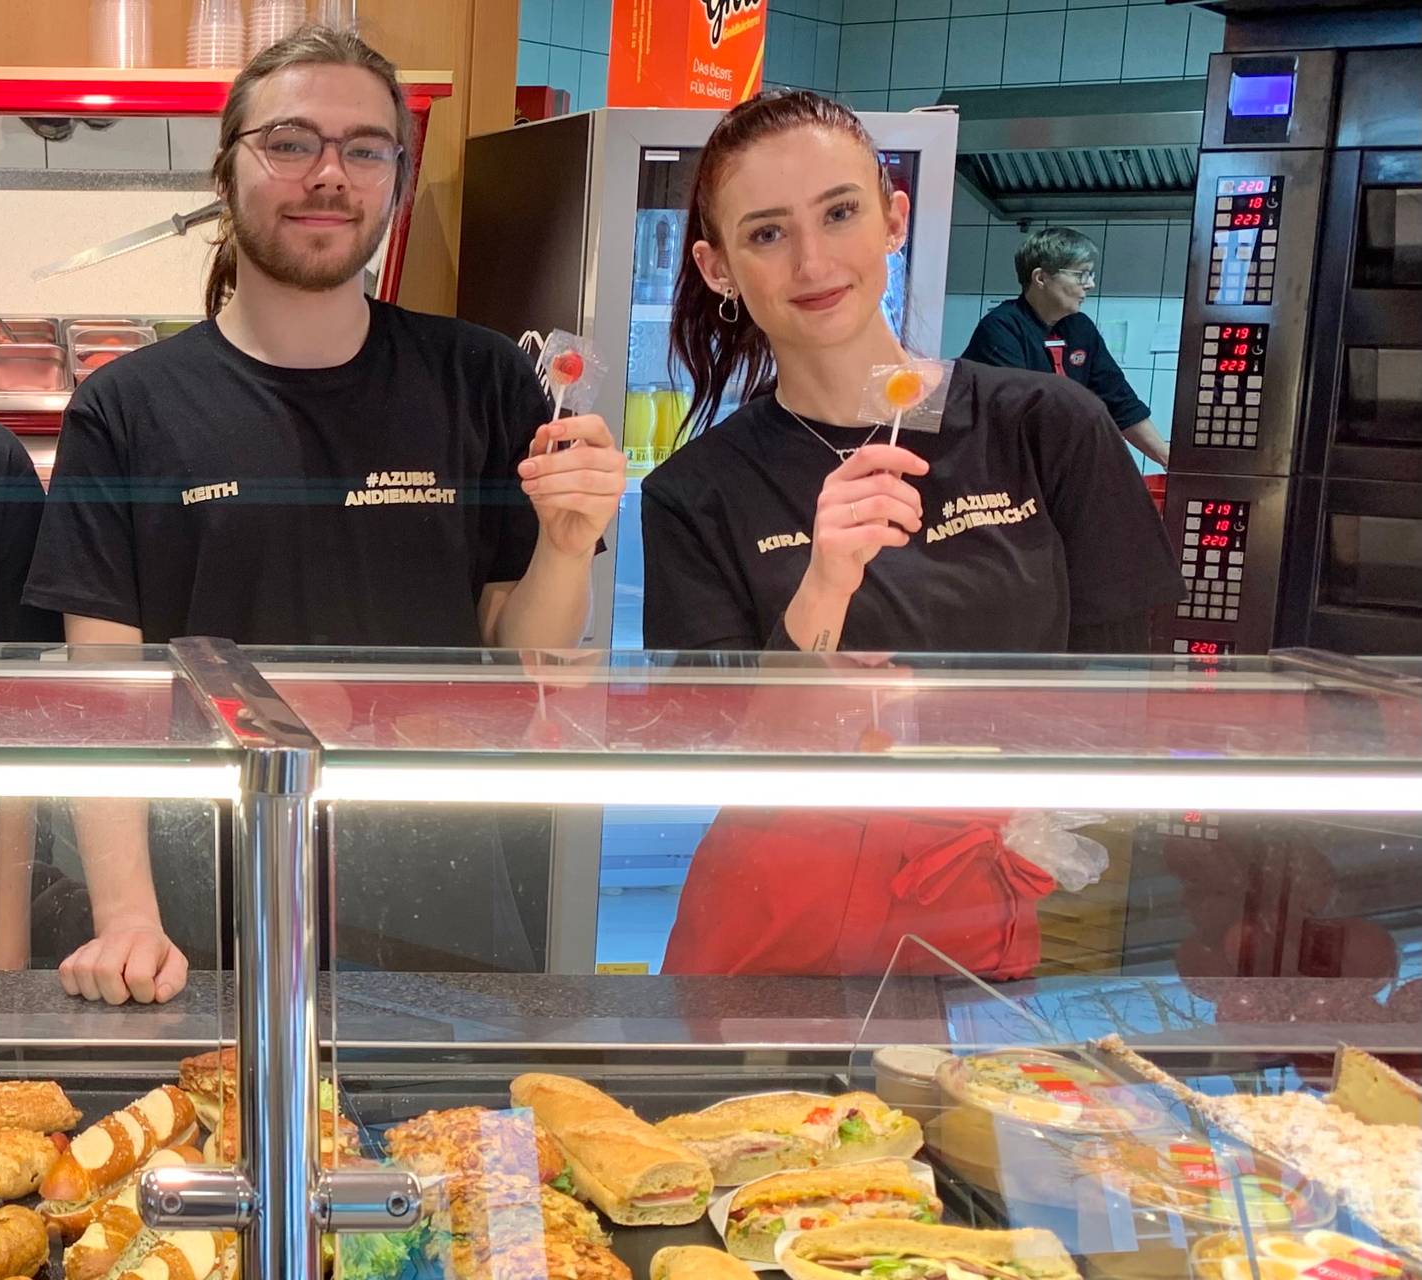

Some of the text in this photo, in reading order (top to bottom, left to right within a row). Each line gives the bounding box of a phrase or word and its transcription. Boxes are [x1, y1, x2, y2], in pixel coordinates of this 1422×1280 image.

[692, 57, 734, 81] DAS BESTE
[689, 79, 706, 96] FÜR
[1237, 180, 1265, 193] 220
[1248, 197, 1263, 209] 18
[1234, 213, 1261, 226] 223
[1222, 327, 1250, 339] 219
[1219, 360, 1247, 372] 223
[366, 471, 436, 488] #AZUBIS
[181, 481, 240, 506] KEITH
[344, 488, 457, 507] ANDIEMACHT
[941, 492, 1012, 519] #AZUBIS
[1205, 503, 1231, 515] 219
[925, 498, 1038, 544] ANDIEMACHT
[757, 531, 812, 554] KIRA
[1201, 535, 1228, 547] 220
[1191, 641, 1218, 654] 220
